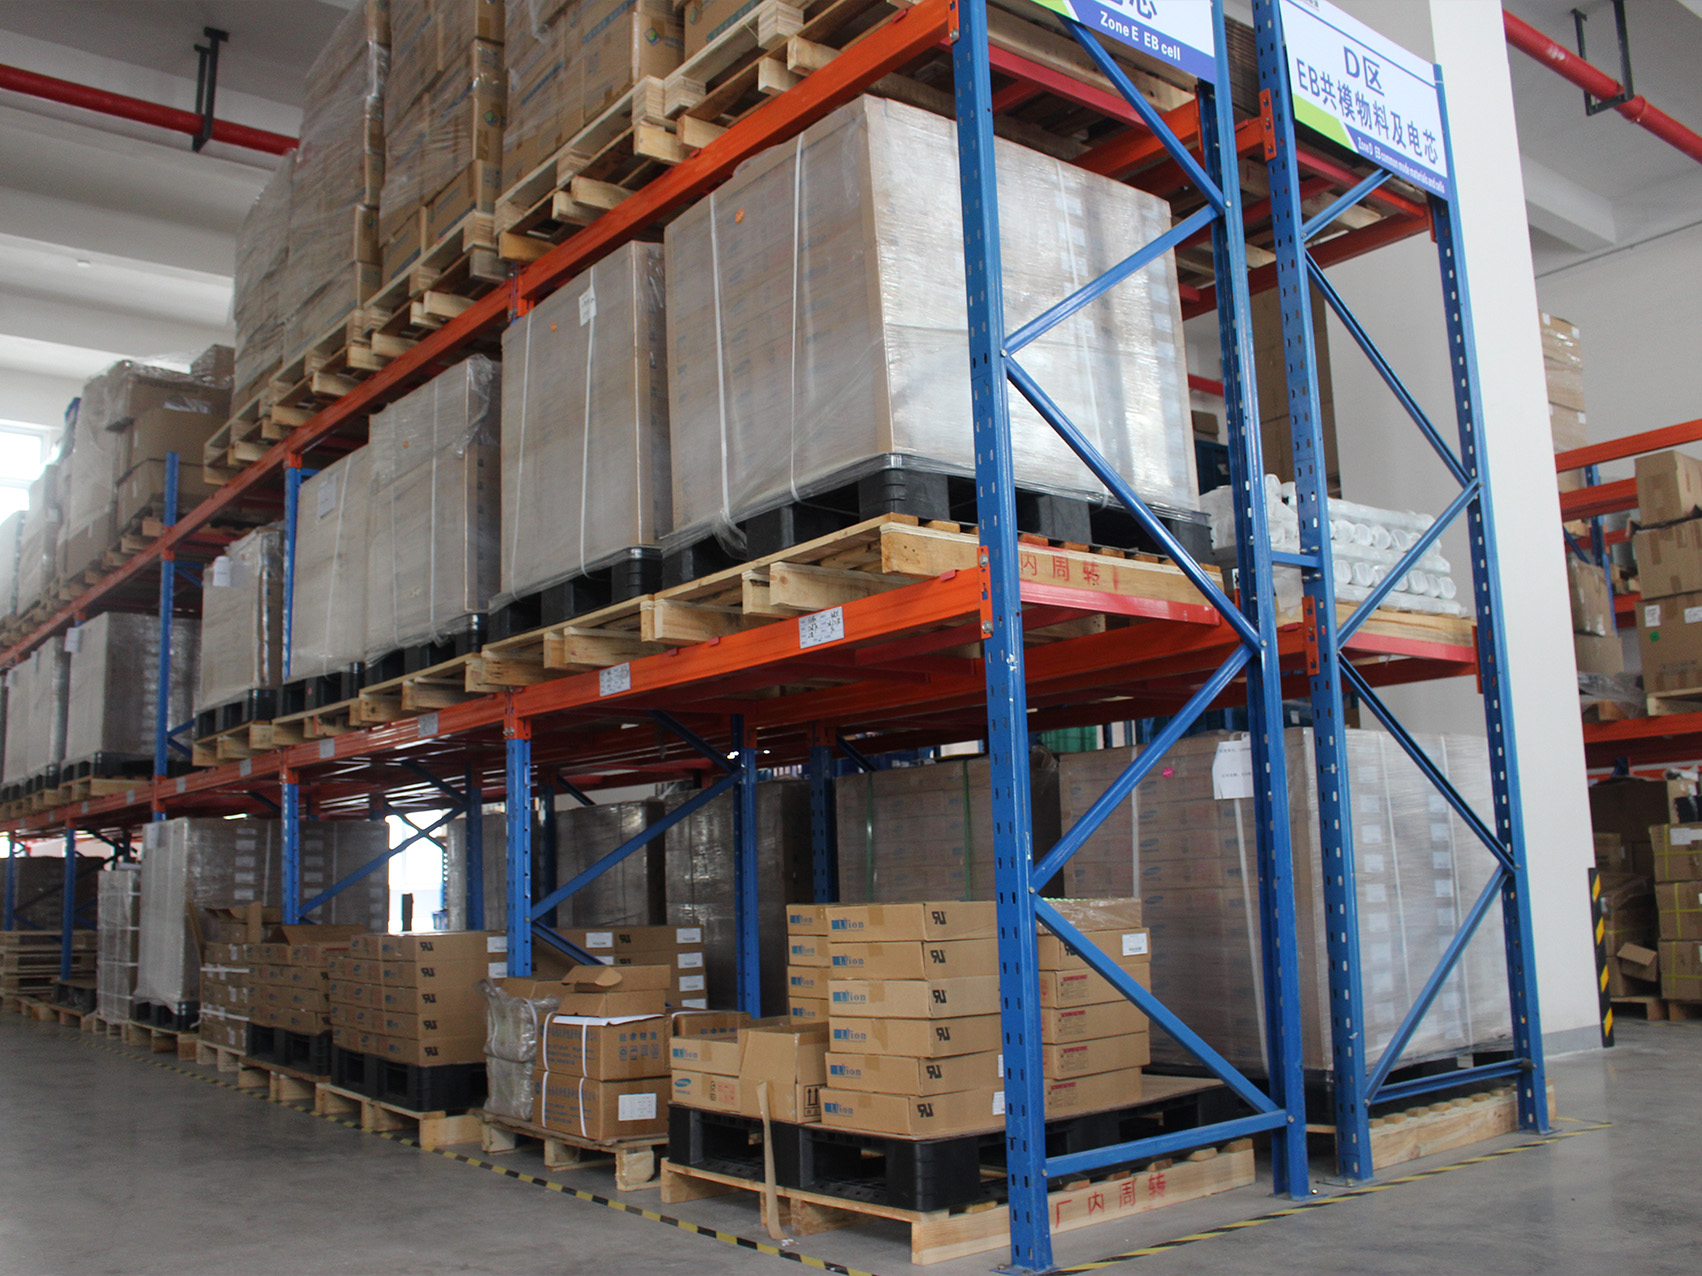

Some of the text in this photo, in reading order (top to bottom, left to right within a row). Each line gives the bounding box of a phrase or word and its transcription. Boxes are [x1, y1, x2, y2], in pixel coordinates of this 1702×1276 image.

[1100, 10, 1181, 61] Zone E EB cell
[1343, 46, 1385, 97] D区
[1296, 57, 1438, 165] EB共模物料及电芯
[1055, 1172, 1167, 1229] 厂内周转
